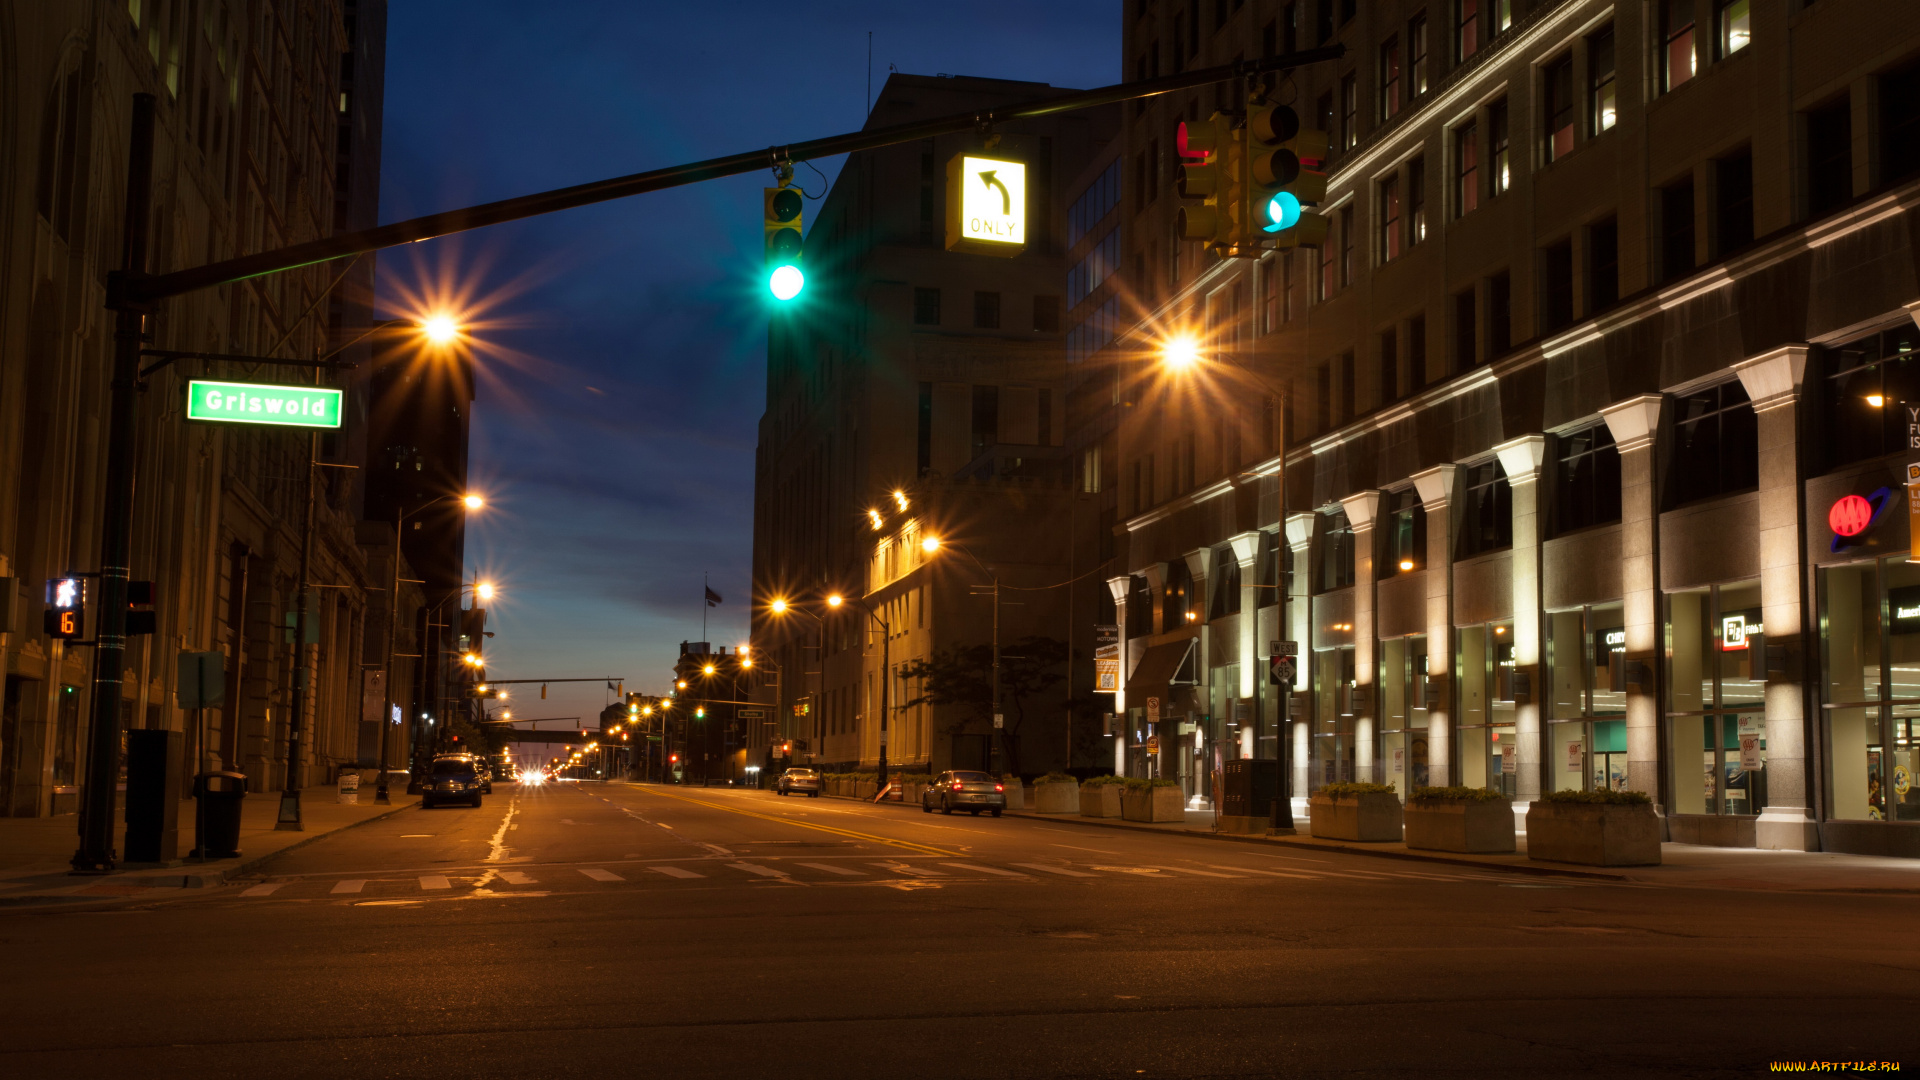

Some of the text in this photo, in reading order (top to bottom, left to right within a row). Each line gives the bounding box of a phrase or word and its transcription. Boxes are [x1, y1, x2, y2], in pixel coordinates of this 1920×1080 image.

[971, 217, 1016, 237] ONLY
[205, 390, 326, 417] Griswold
[61, 611, 74, 634] 16
[1745, 624, 1759, 635] Fifth
[1273, 643, 1296, 653] WEST
[1277, 666, 1290, 678] 85
